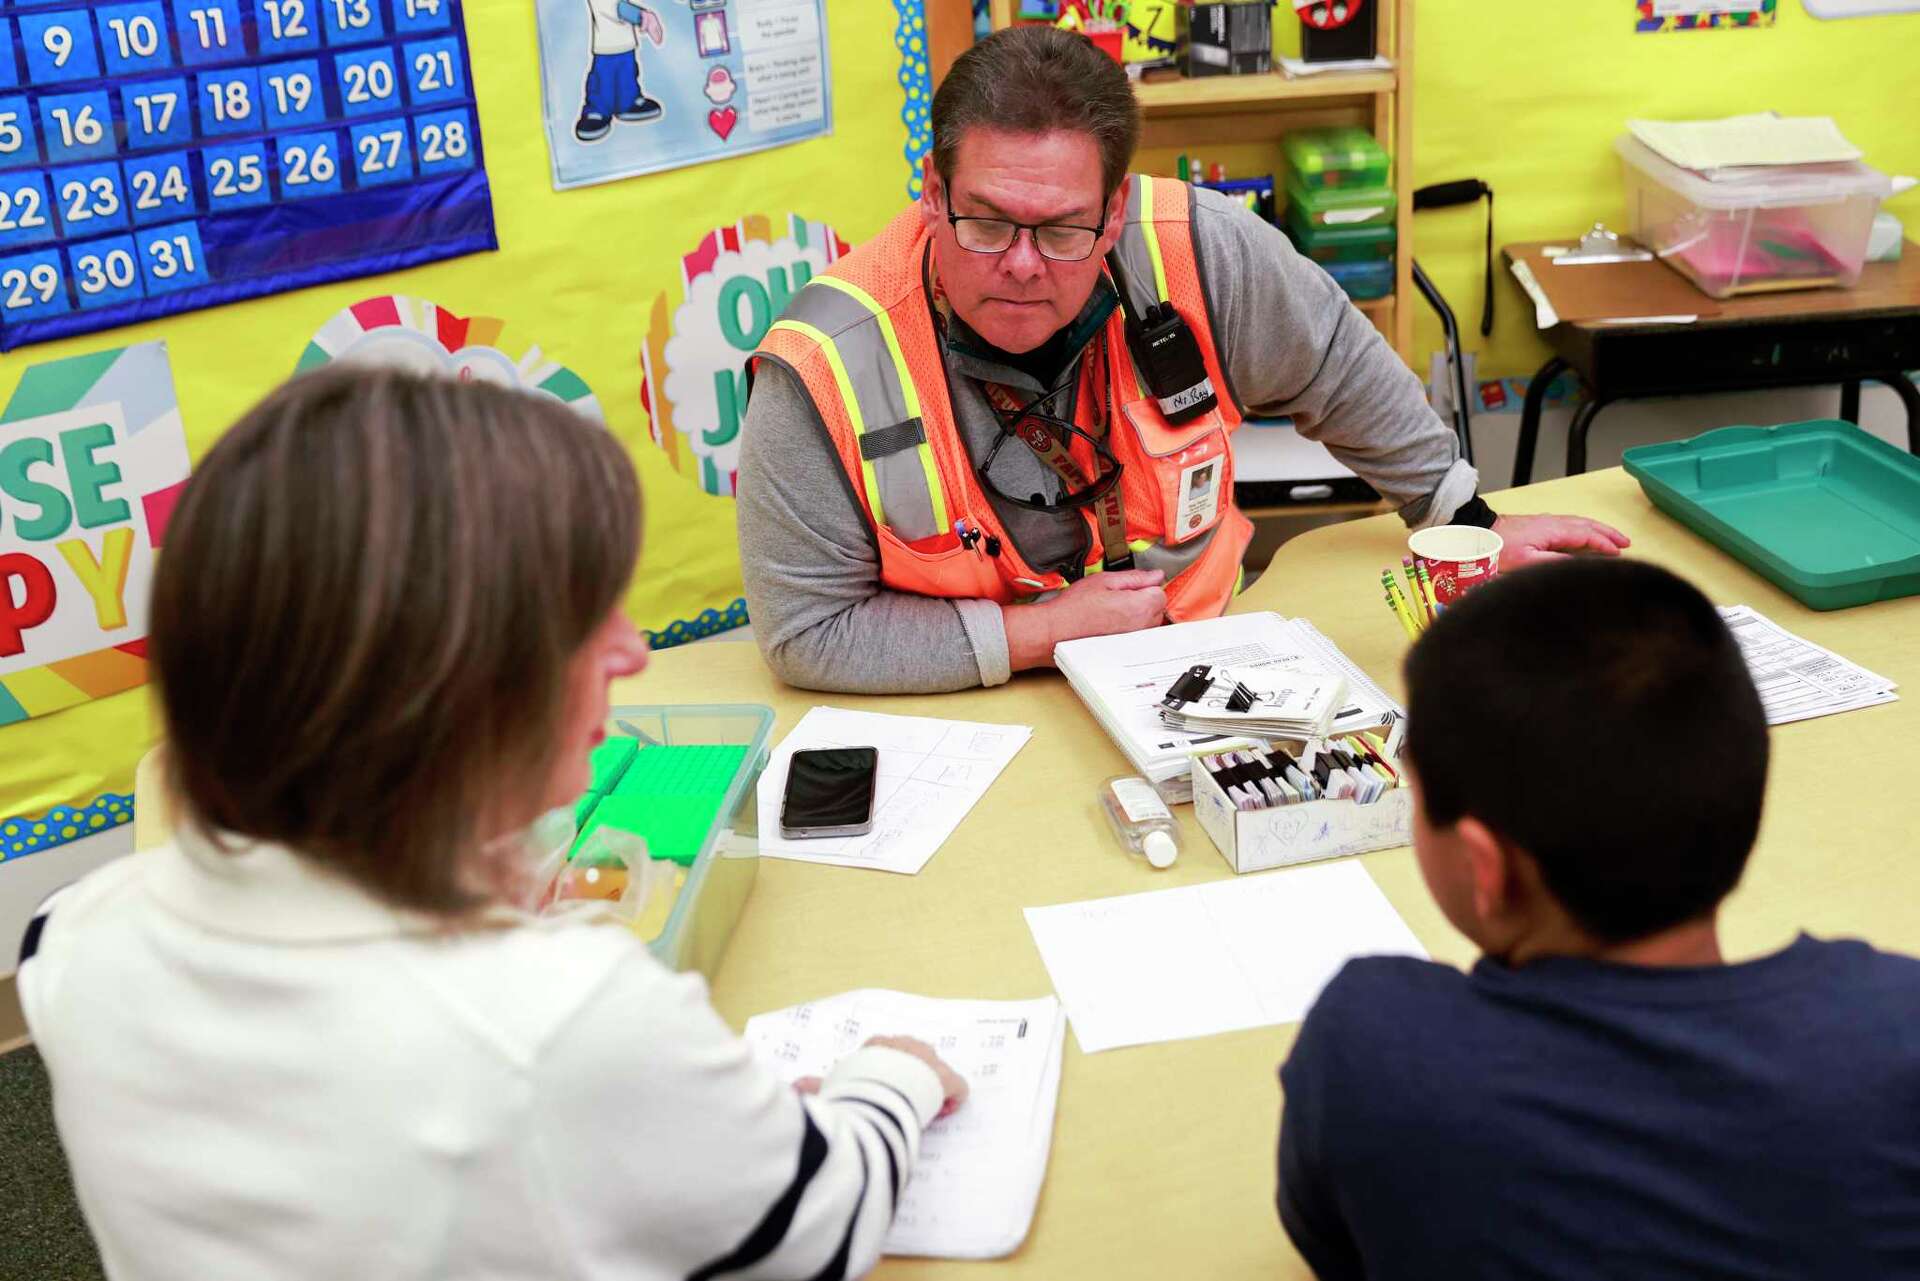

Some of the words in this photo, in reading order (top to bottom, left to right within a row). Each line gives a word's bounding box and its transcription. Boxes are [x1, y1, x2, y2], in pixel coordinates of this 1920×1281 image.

[43, 26, 72, 66] 9
[109, 16, 158, 58] 10
[190, 8, 227, 48] 11
[264, 0, 308, 38] 12
[331, 0, 371, 29] 13
[52, 105, 103, 146] 16
[134, 93, 177, 133] 17
[207, 81, 250, 121] 18
[269, 74, 312, 113] 19
[344, 61, 393, 102] 20
[415, 51, 453, 90] 21
[0, 187, 45, 230] 22
[62, 177, 118, 221] 23
[133, 166, 187, 209] 24
[210, 155, 262, 196] 25
[284, 145, 335, 183] 26
[359, 131, 402, 172] 27
[421, 121, 466, 161] 28
[2, 264, 57, 308] 29
[78, 250, 134, 293] 30
[150, 236, 194, 277] 31
[702, 367, 747, 447] J
[0, 526, 135, 658] PY
